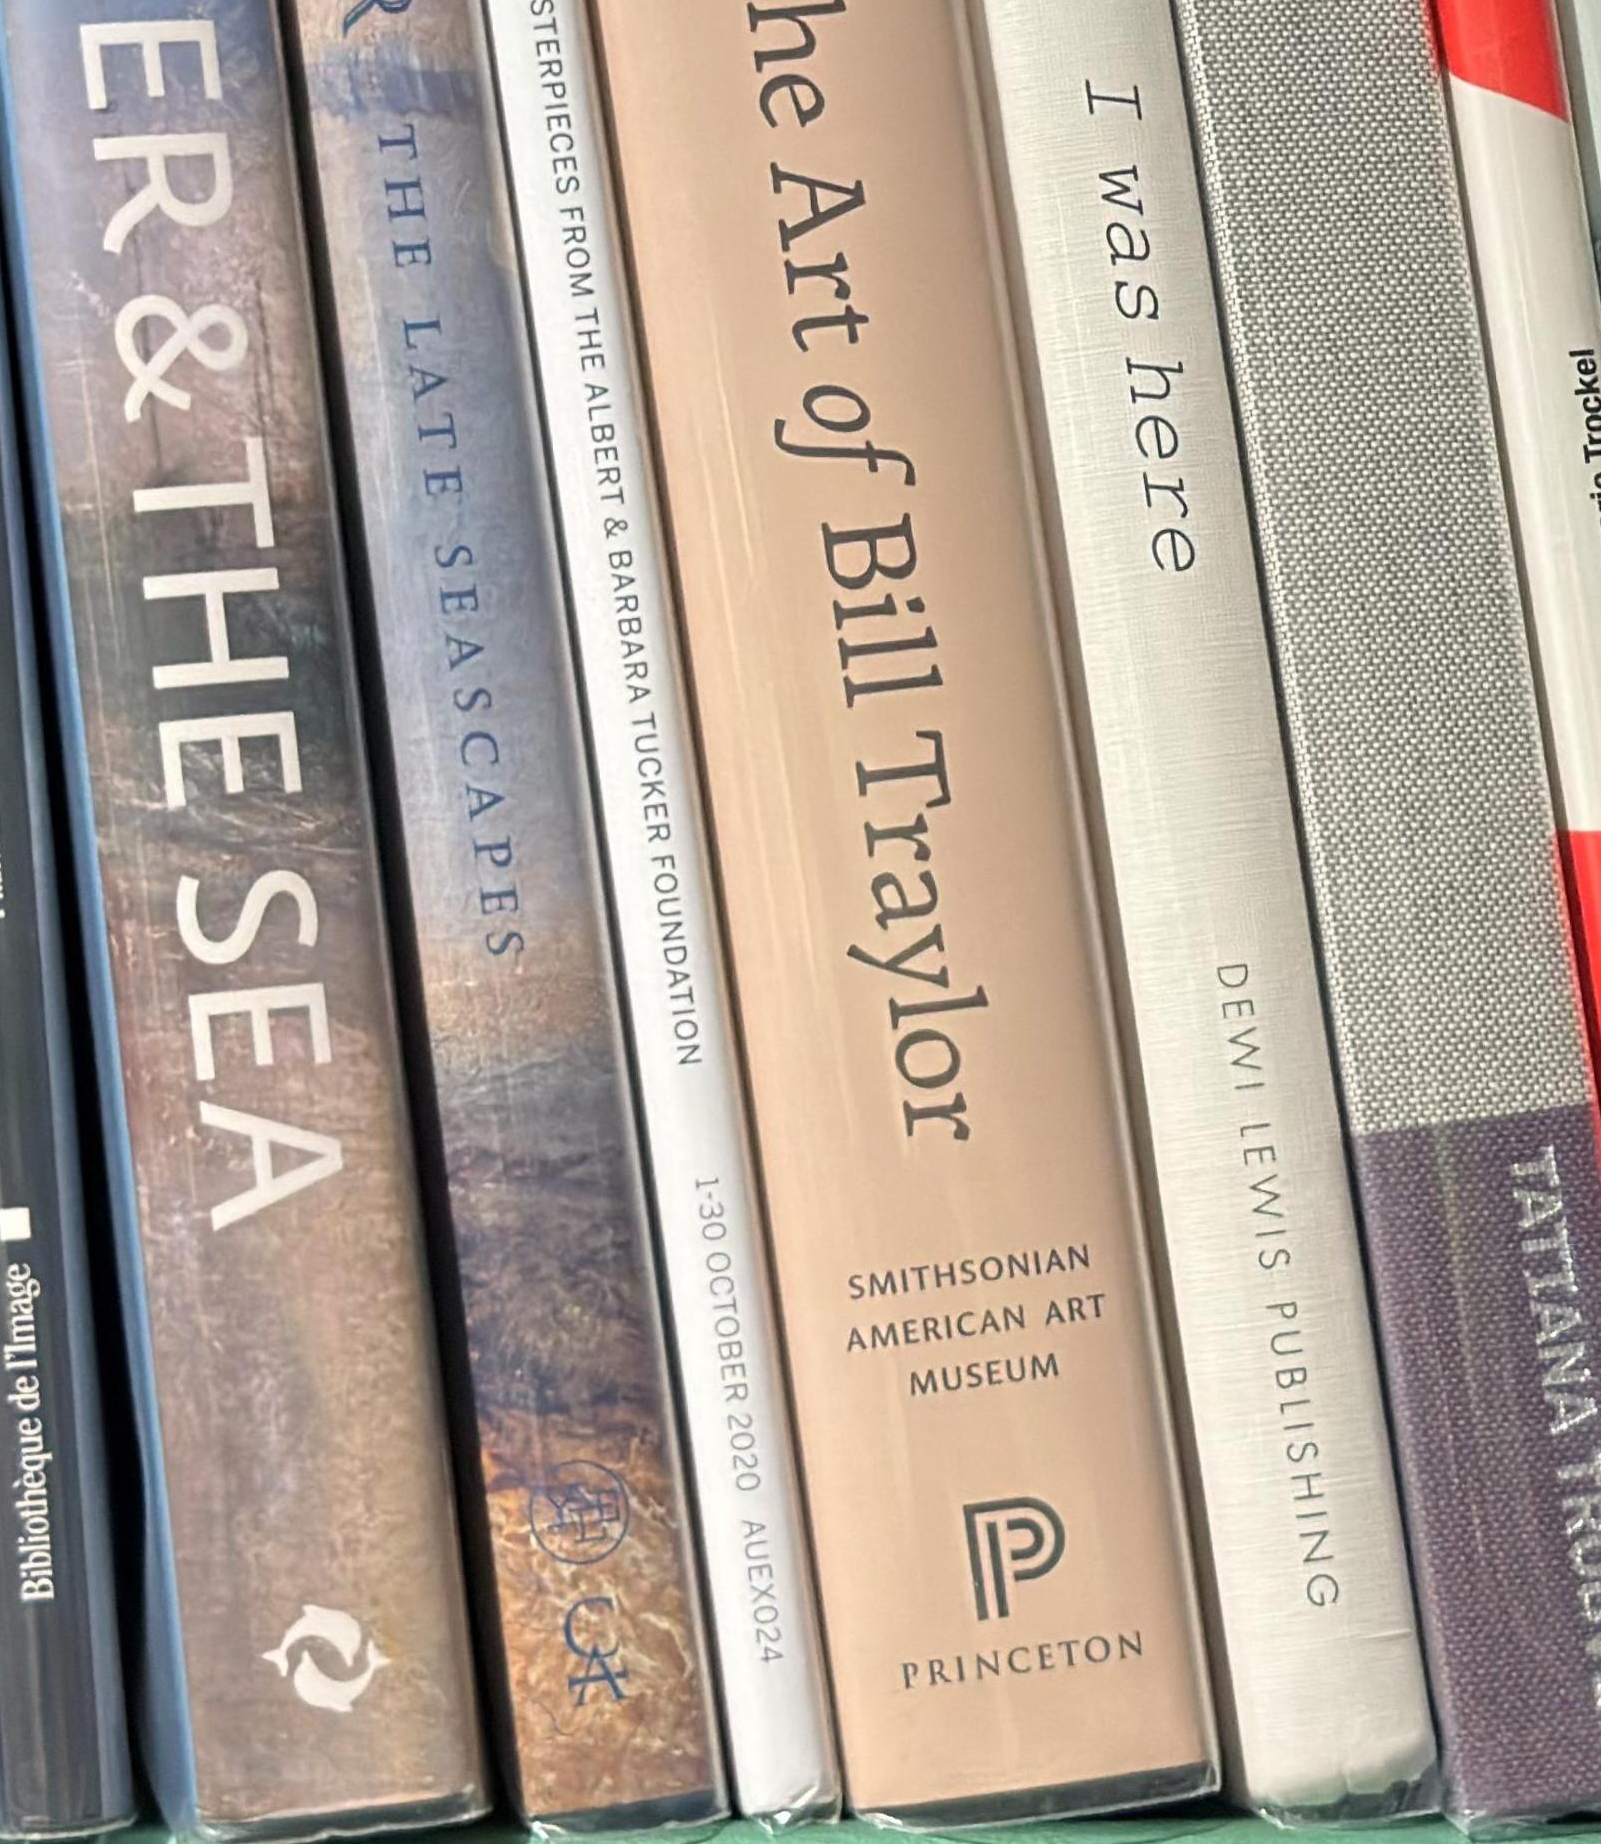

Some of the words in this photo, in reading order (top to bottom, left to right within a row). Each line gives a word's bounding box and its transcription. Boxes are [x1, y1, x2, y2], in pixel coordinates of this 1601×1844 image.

[1084, 77, 1142, 120] I
[378, 123, 431, 268] THE
[558, 206, 595, 298] FROM
[770, 160, 870, 352] Art
[1100, 163, 1159, 322] was
[115, 293, 248, 423] &
[403, 317, 463, 497] LATE
[573, 304, 606, 370] THE
[584, 380, 627, 509] ALBERT
[773, 383, 917, 487] of
[1125, 357, 1197, 573] here
[133, 435, 304, 810] THE
[607, 547, 651, 704] BARBARA
[820, 511, 945, 709] Bill
[434, 543, 526, 957] SEASCAPES
[627, 710, 672, 844] TUCKER
[651, 853, 703, 1066] FOUNDATION
[846, 729, 989, 1141] Traylor
[175, 868, 344, 1232] SEA
[695, 1176, 727, 1241] 1-30
[848, 1243, 1091, 1300] SMITHSONIAN
[705, 1250, 749, 1404] OCTOBER
[846, 1304, 1026, 1353] AMERICAN
[1045, 1293, 1107, 1328] ART
[1216, 963, 1264, 1092] DEWI
[1240, 1122, 1291, 1271] LEWIS
[1266, 1300, 1340, 1608] PUBLISHING
[1512, 1144, 1599, 1436] TATIANA
[909, 1353, 1060, 1396] MUSEUM
[13, 1417, 55, 1601] Bibliothèque
[727, 1413, 761, 1492] 2020
[741, 1519, 786, 1663] AUEX024
[902, 1630, 1143, 1690] PRINCETON
